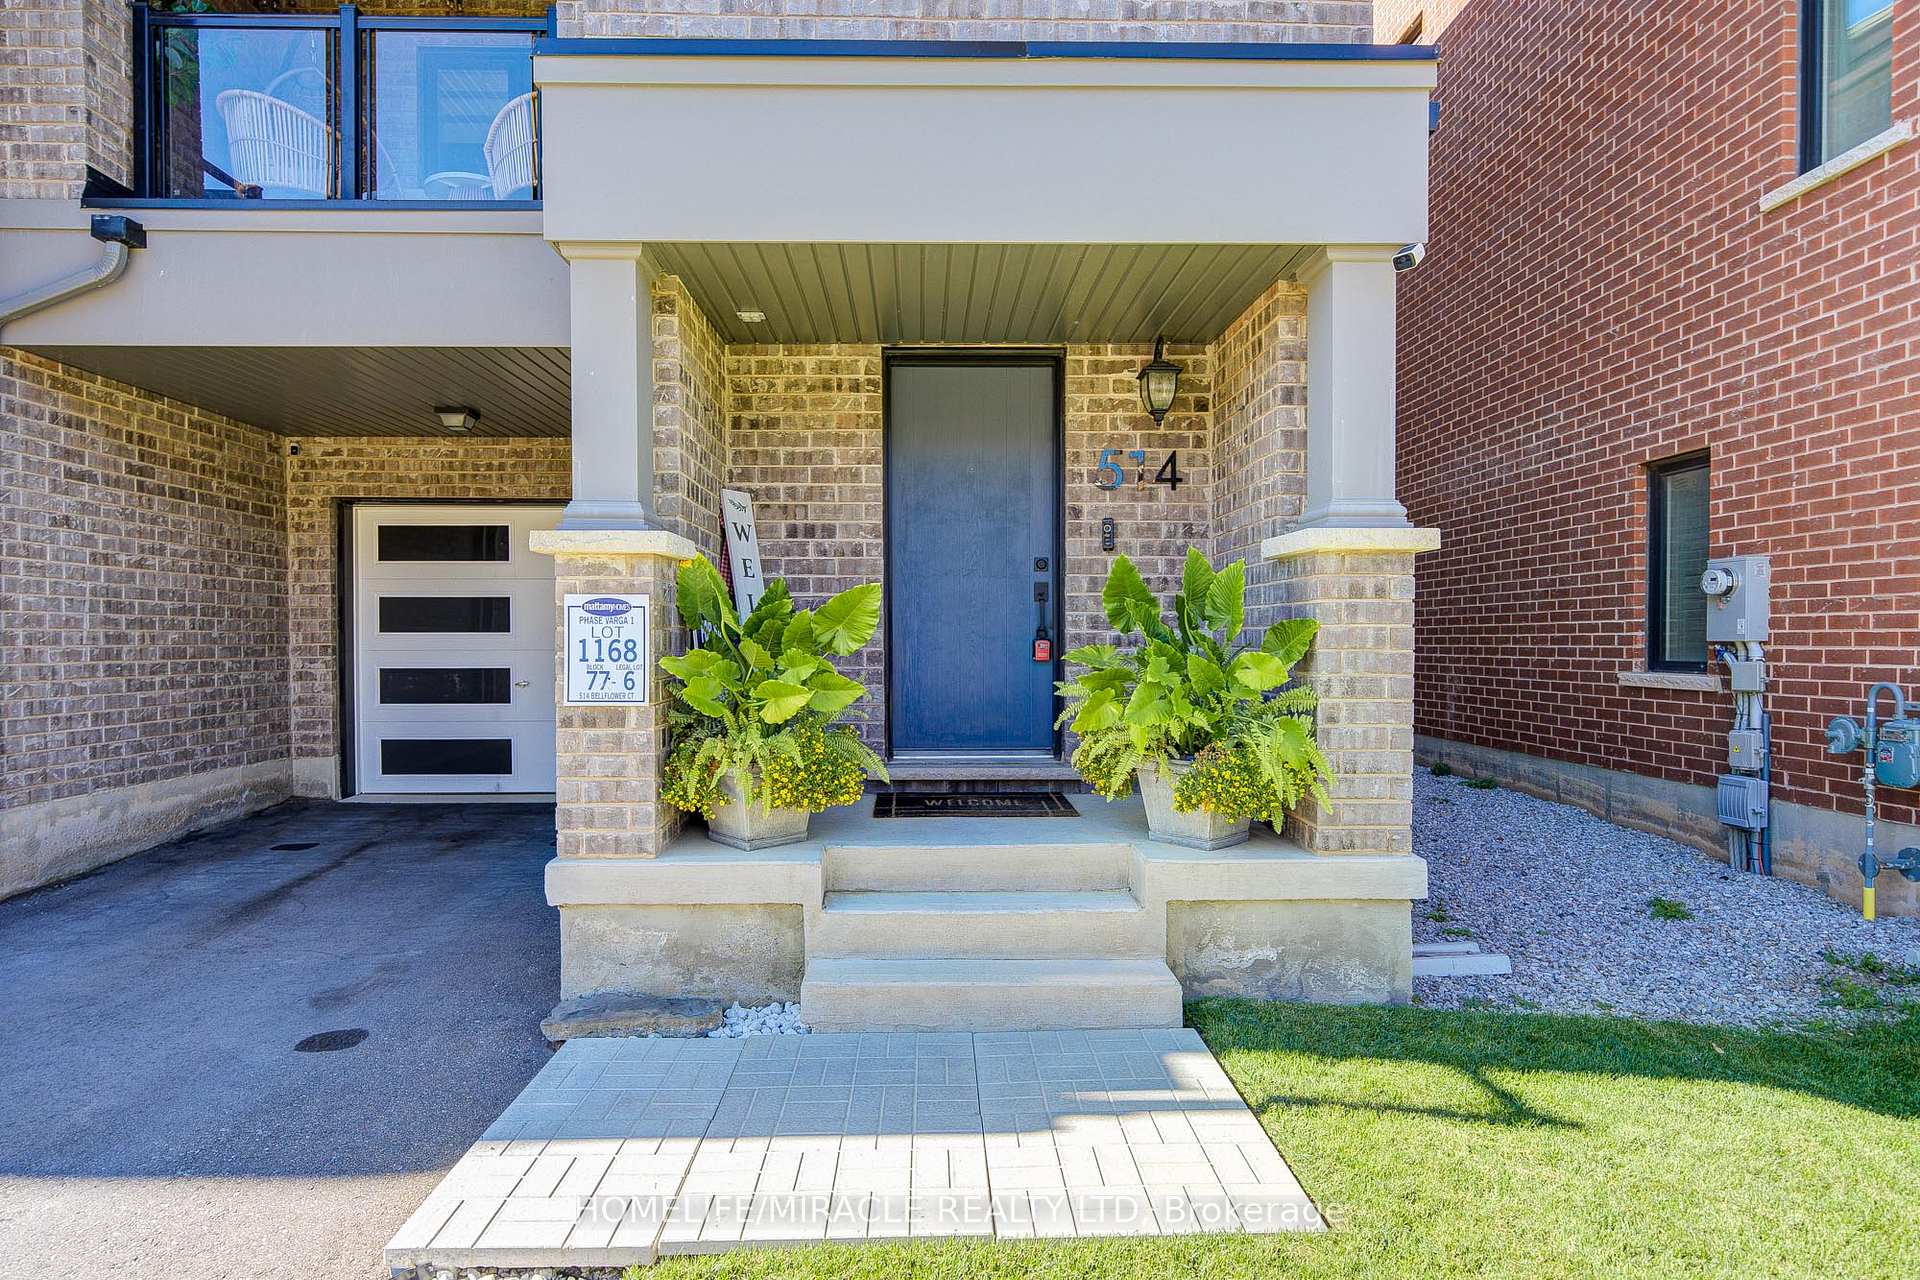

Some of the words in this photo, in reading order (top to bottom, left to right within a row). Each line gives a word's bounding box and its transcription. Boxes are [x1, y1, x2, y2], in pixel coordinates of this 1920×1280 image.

[579, 616, 603, 624] PHASE
[606, 616, 629, 624] VARGA
[591, 626, 624, 638] LOT
[579, 639, 637, 662] 1168
[624, 671, 635, 690] 6
[627, 692, 635, 700] CT
